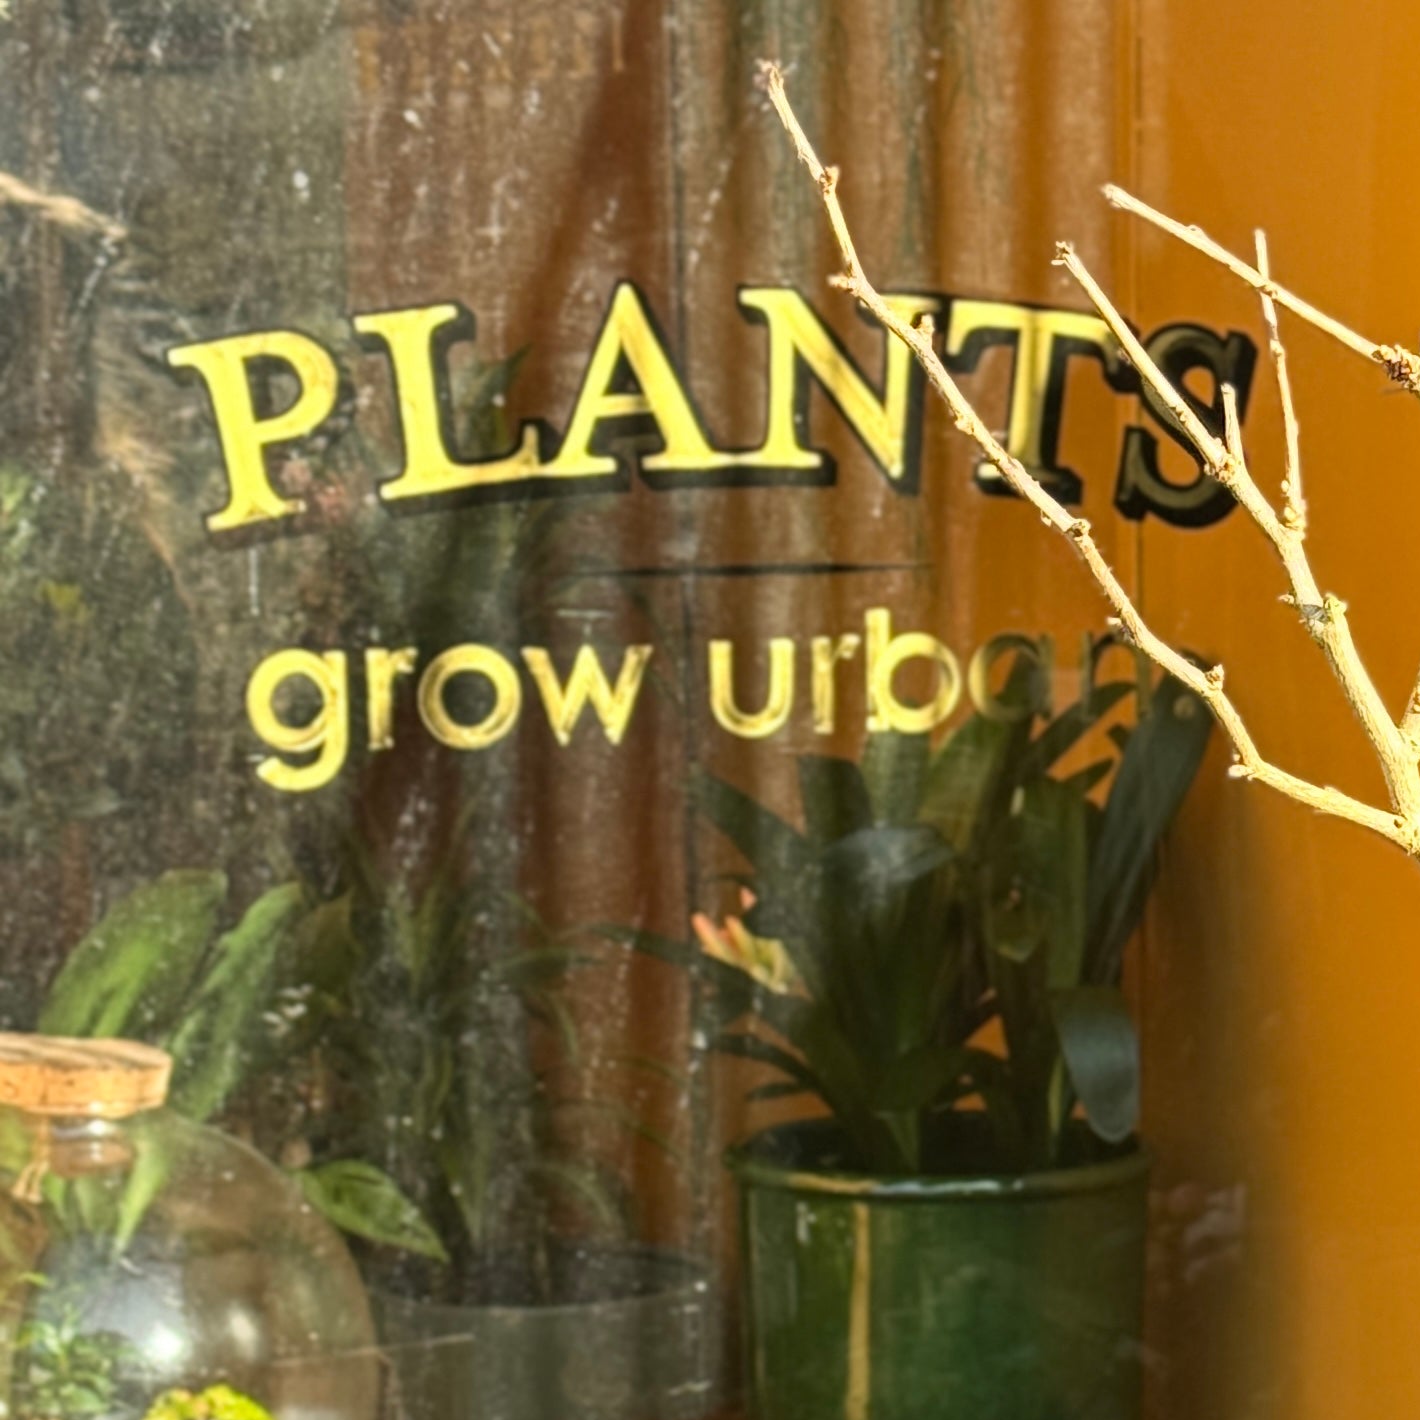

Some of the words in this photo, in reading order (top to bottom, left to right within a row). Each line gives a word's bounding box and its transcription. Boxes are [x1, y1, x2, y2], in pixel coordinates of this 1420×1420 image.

[168, 281, 1258, 545] PLANTS
[245, 640, 654, 792] grow
[706, 607, 1150, 742] urban
